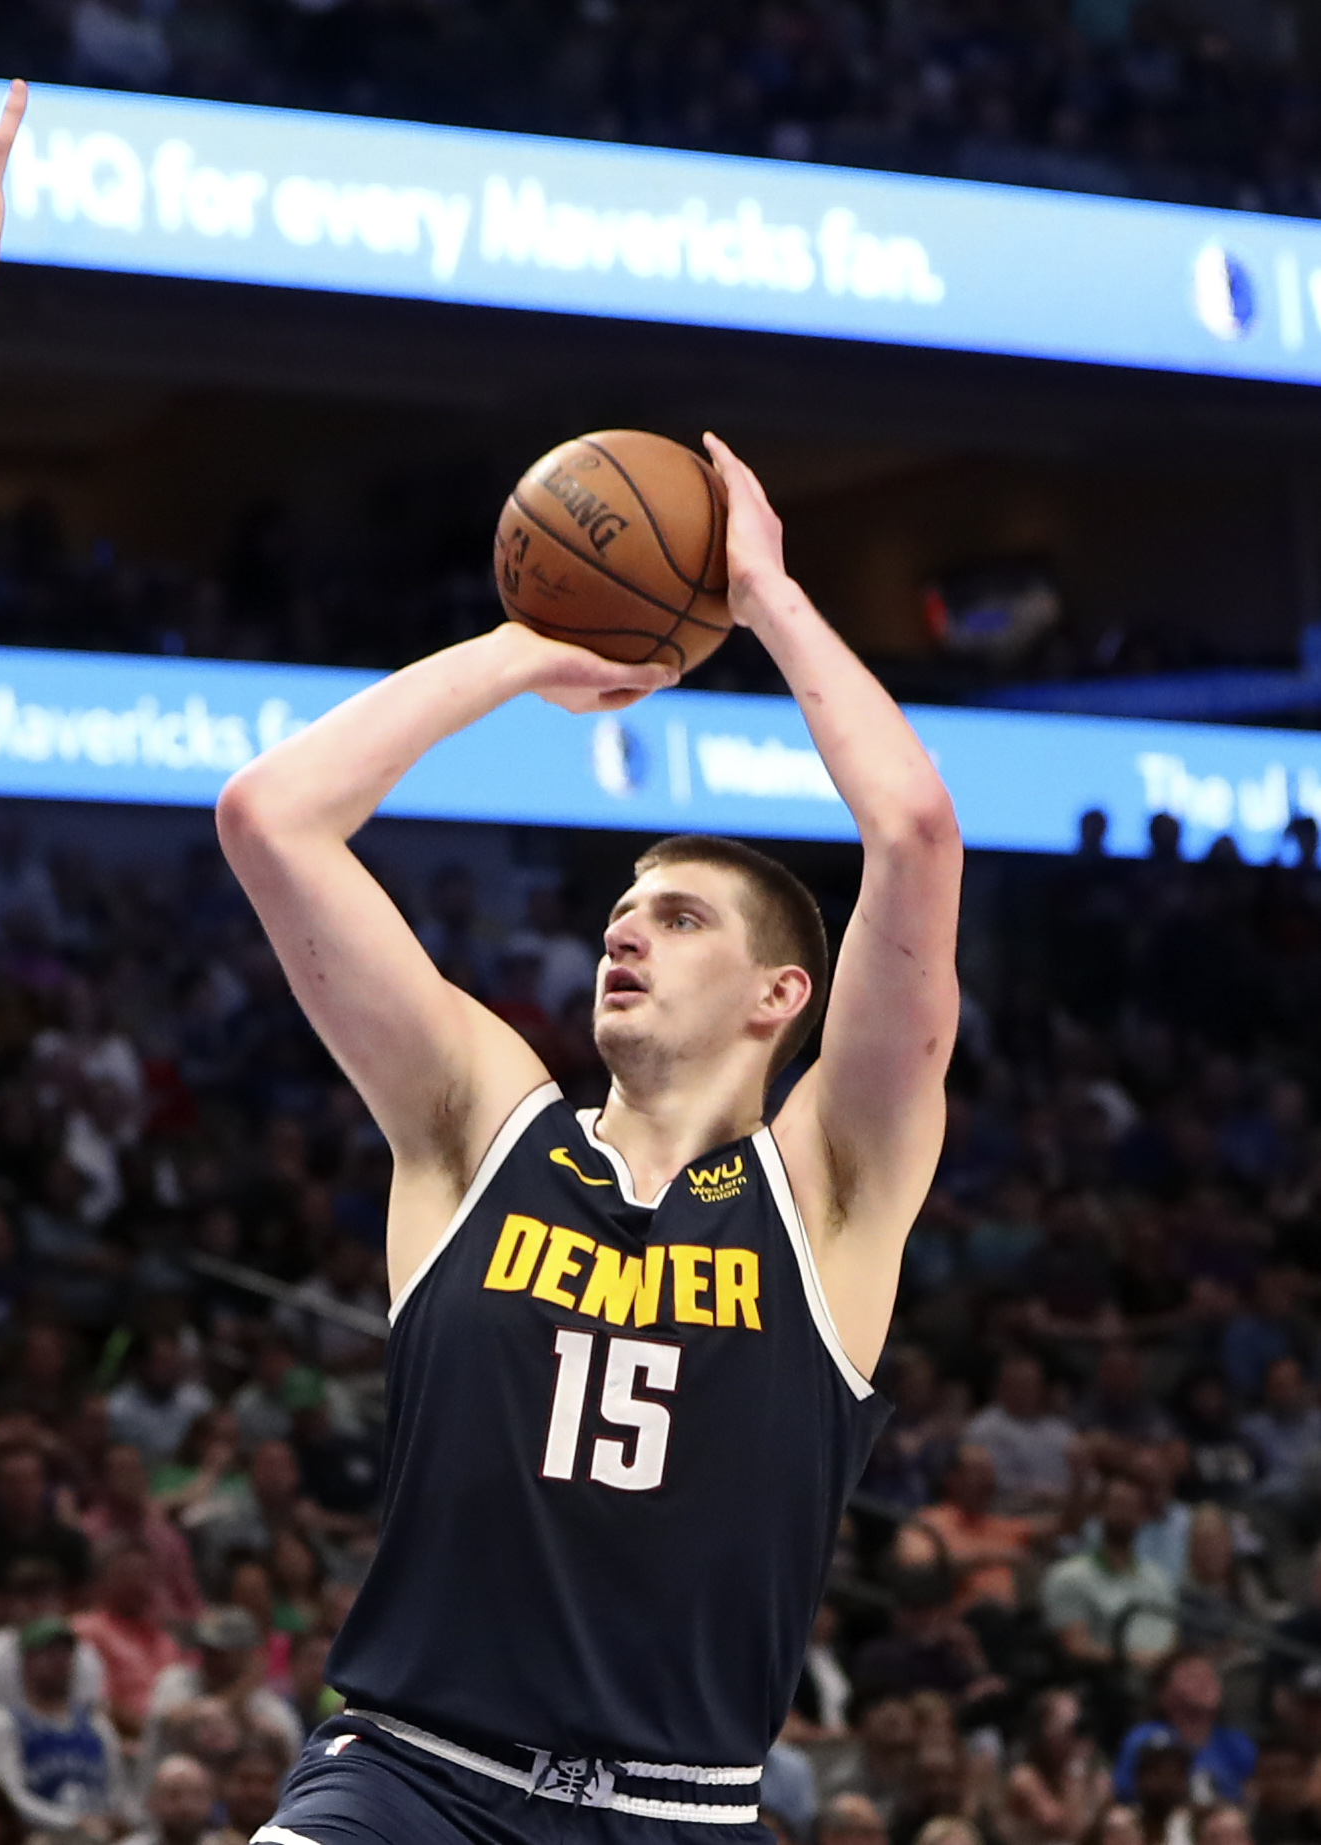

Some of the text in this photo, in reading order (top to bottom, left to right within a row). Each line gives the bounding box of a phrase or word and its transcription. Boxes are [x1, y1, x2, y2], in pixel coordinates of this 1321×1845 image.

[9, 124, 145, 235] HQ
[152, 138, 268, 240] for
[273, 175, 472, 282] every
[480, 173, 816, 294] Mavericks
[820, 206, 946, 306] fan.
[1134, 750, 1235, 830] The
[687, 1155, 743, 1185] WU
[689, 1176, 747, 1195] Western
[701, 1187, 740, 1202] Union
[538, 1325, 684, 1491] 15
